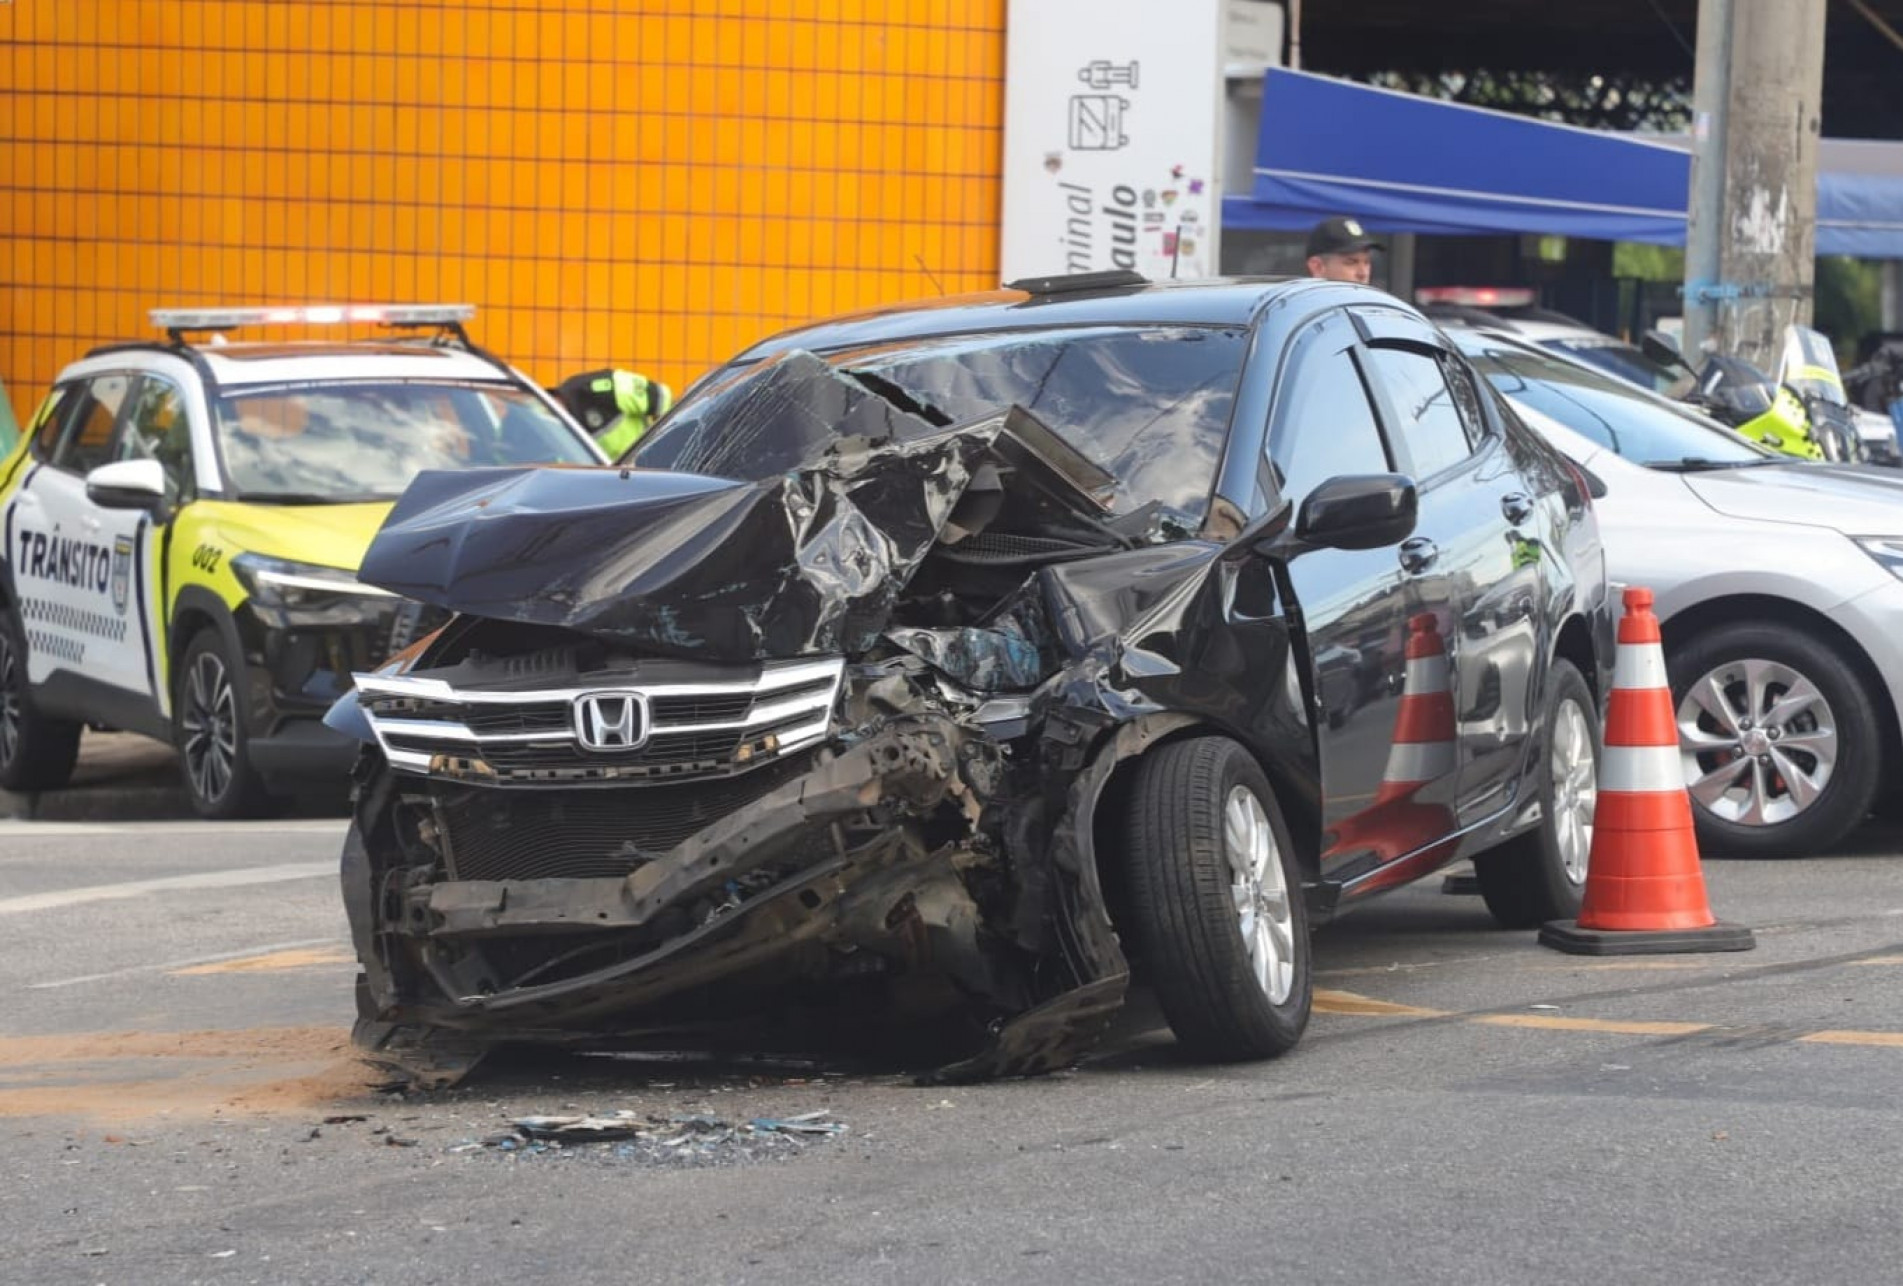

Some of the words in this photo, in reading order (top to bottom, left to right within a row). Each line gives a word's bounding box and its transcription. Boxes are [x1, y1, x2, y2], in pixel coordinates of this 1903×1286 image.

[1058, 182, 1092, 274] minal
[1102, 185, 1137, 271] aulo
[192, 545, 222, 573] 002
